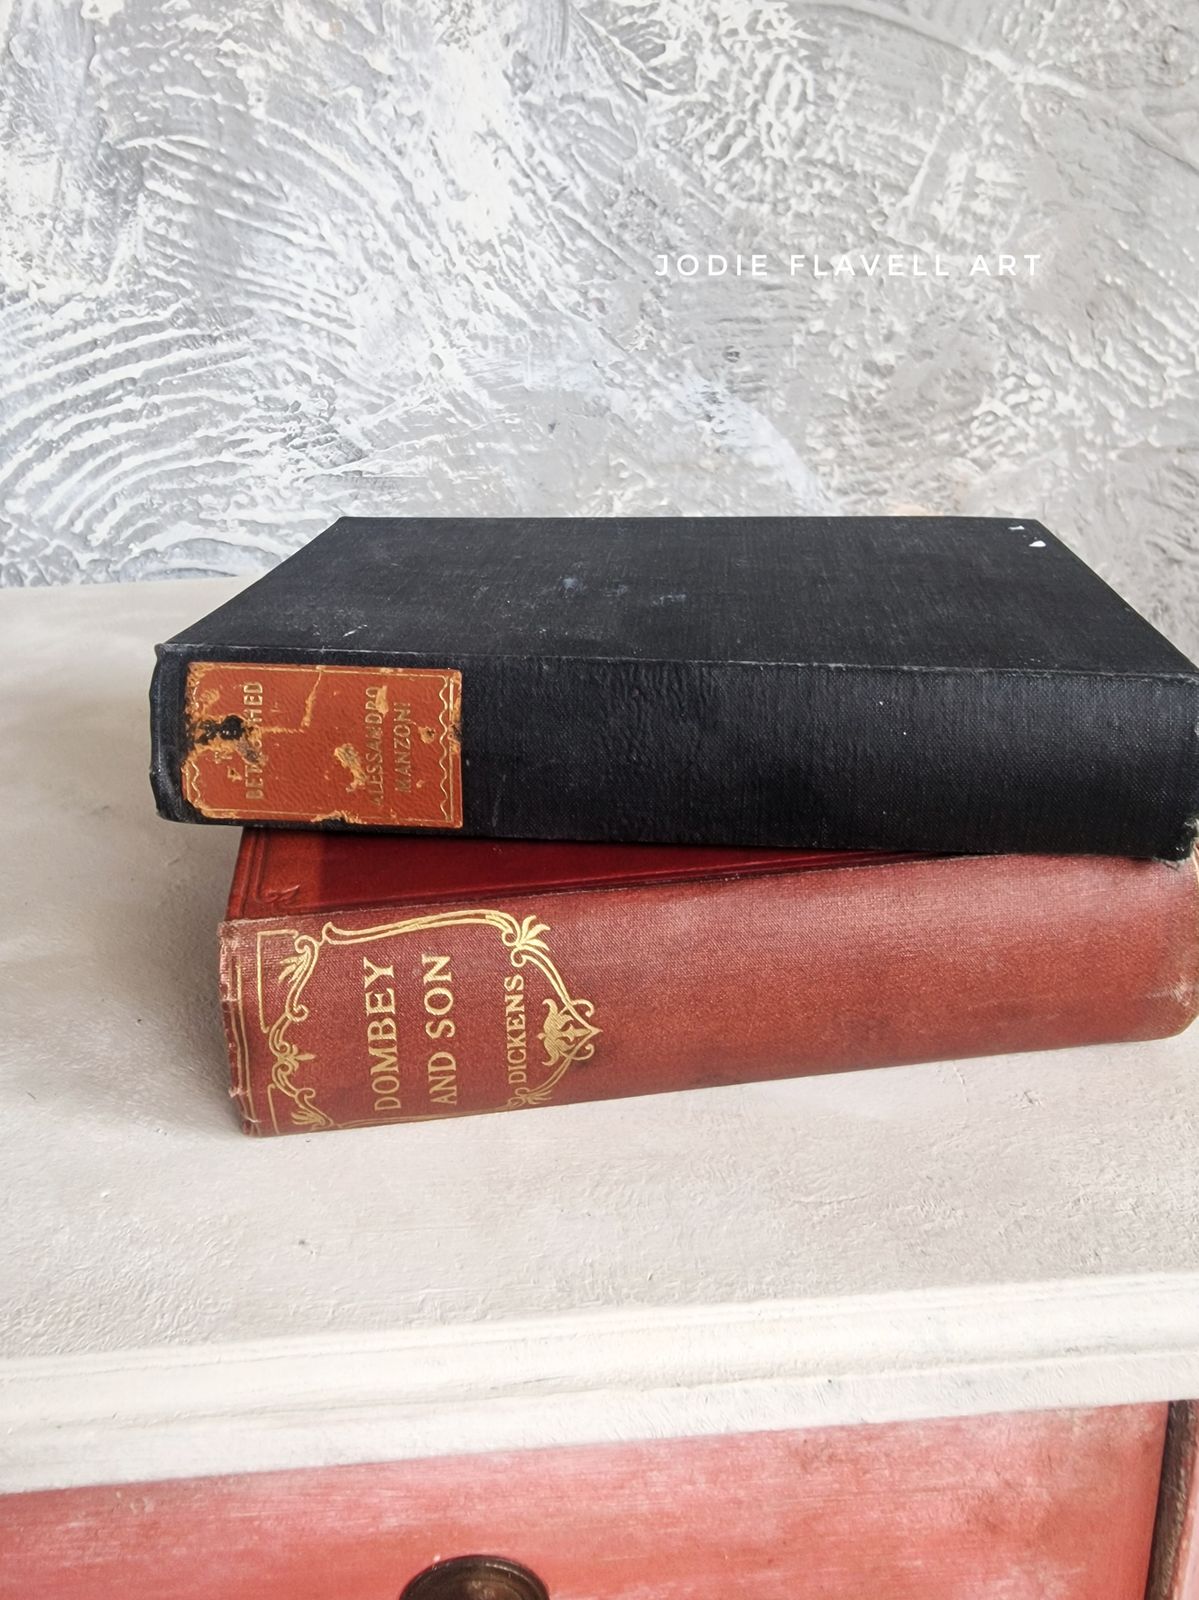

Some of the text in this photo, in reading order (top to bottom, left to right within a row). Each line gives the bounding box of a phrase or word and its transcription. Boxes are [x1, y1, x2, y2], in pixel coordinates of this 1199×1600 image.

[363, 956, 402, 1111] DOMBEY
[421, 953, 458, 1105] AND SON
[504, 973, 528, 1084] DICKENS
